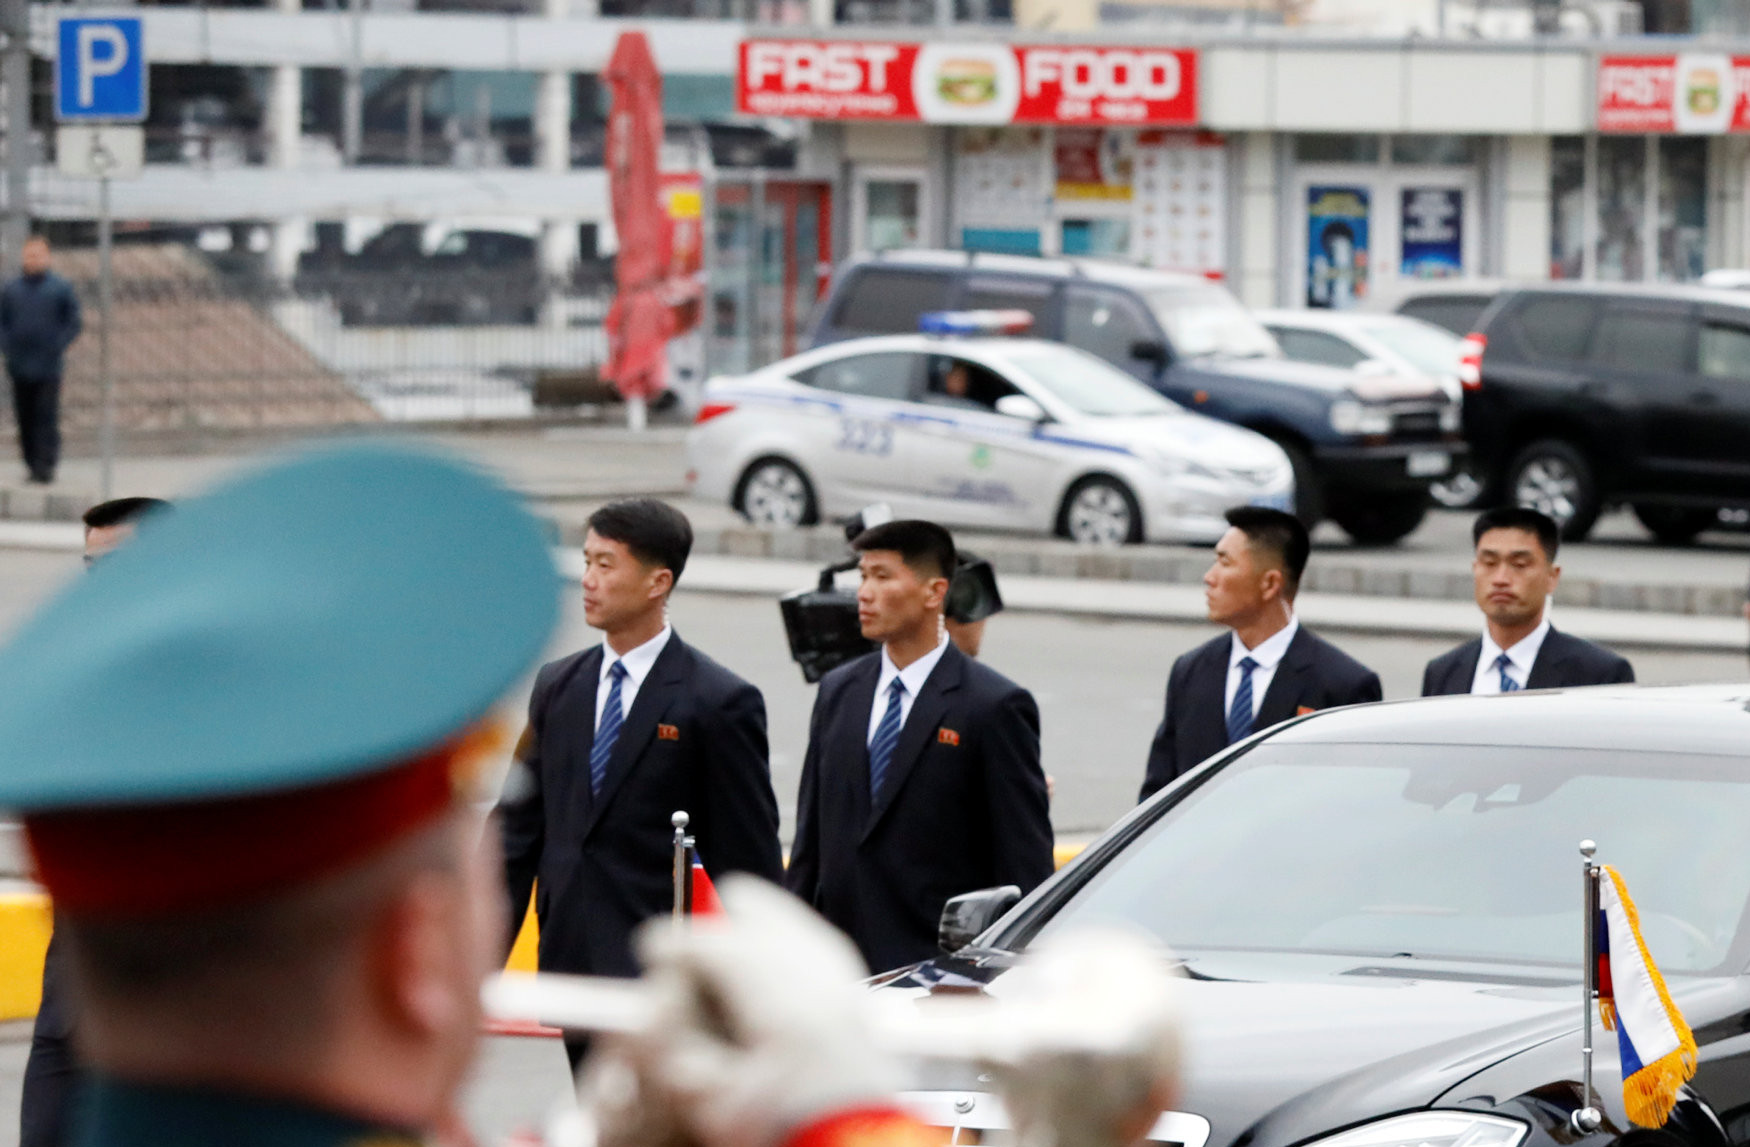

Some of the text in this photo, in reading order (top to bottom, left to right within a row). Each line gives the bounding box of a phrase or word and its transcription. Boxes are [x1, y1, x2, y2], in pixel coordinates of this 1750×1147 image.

[77, 24, 129, 108] P
[747, 44, 1181, 101] FAST FOOD
